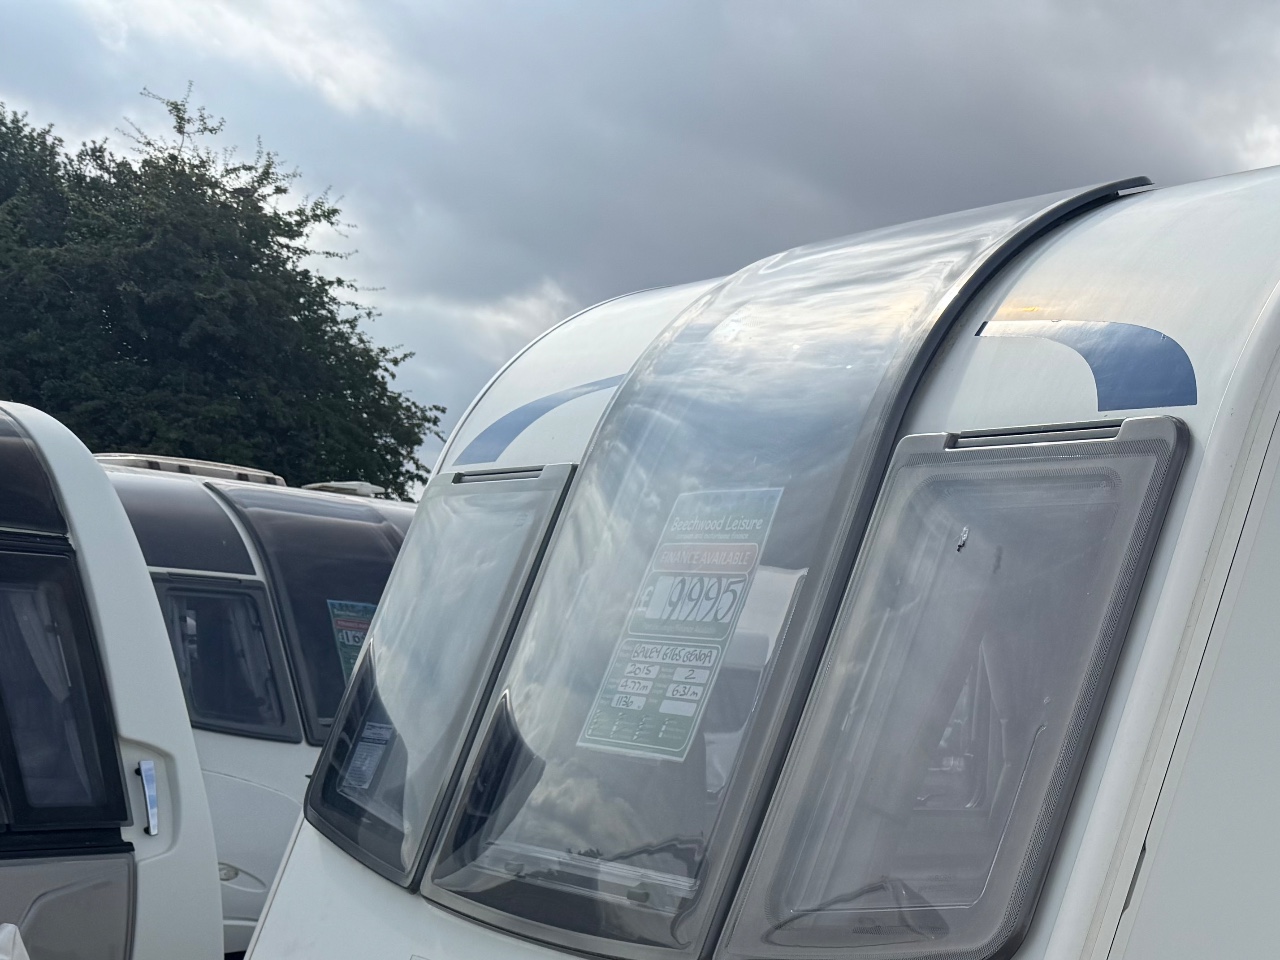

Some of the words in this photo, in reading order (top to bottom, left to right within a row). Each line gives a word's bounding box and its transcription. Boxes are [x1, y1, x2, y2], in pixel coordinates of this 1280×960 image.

[671, 516, 726, 532] Beechwood
[725, 516, 764, 531] Leisure
[661, 551, 700, 565] FINANCE
[700, 551, 752, 565] AVAILABLE
[684, 669, 696, 680] 2
